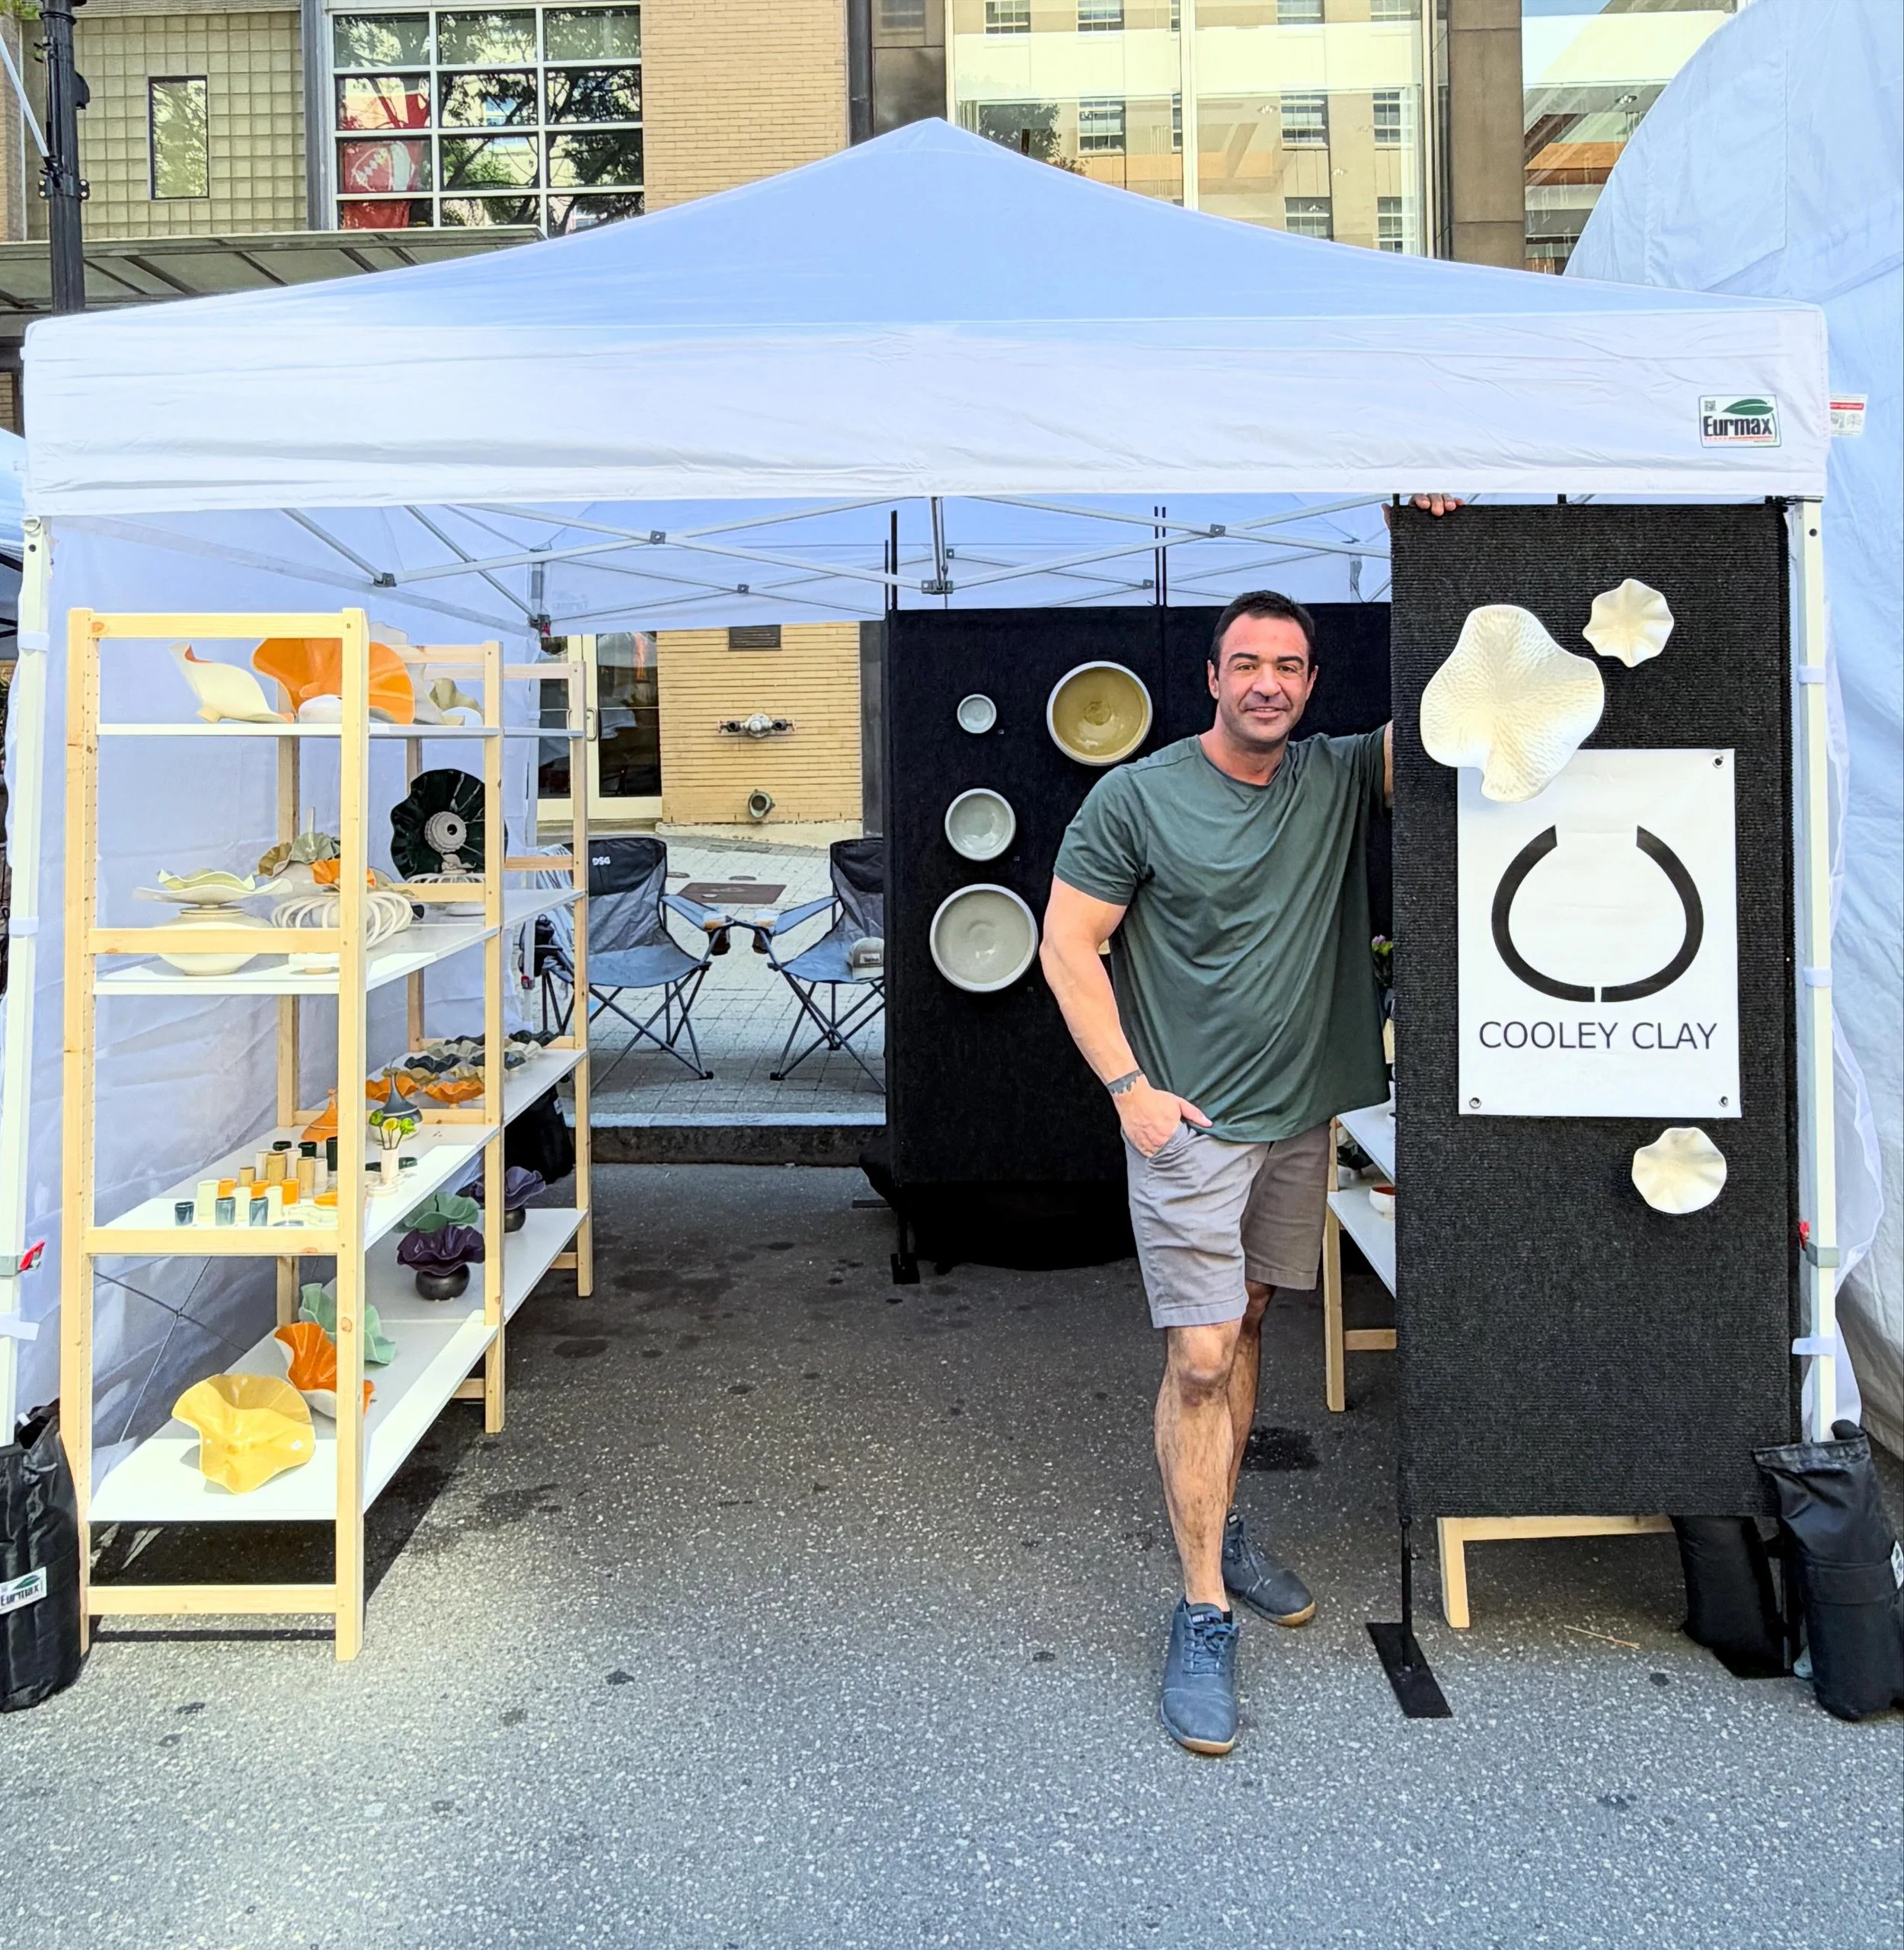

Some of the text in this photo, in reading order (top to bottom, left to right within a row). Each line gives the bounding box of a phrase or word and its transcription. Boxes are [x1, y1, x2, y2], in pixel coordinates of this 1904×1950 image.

[1703, 416, 1773, 436] Eurmax
[592, 856, 611, 866] DSG
[1479, 1021, 1717, 1049] COOLEY CLAY
